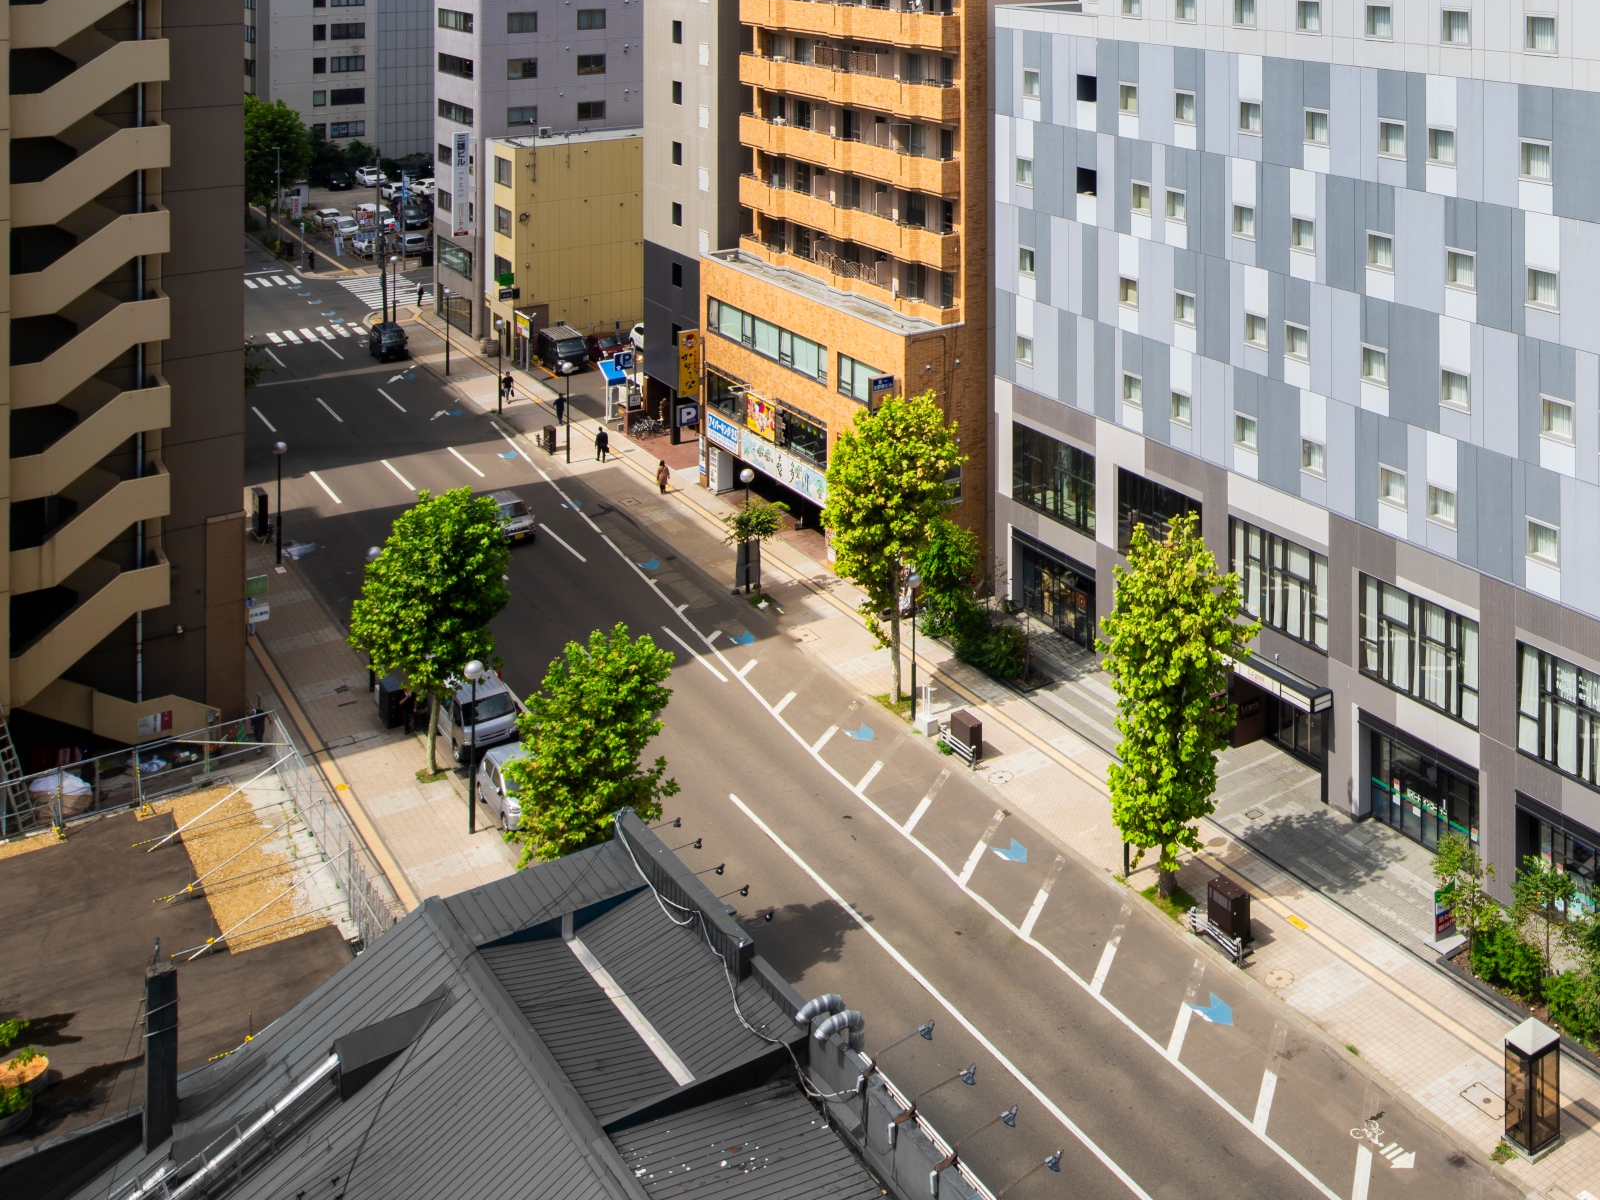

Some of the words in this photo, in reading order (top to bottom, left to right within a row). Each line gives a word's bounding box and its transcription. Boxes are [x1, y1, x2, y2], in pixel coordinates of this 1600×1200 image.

[623, 354, 632, 365] P
[681, 407, 696, 424] P
[1556, 680, 1592, 703] Northern
